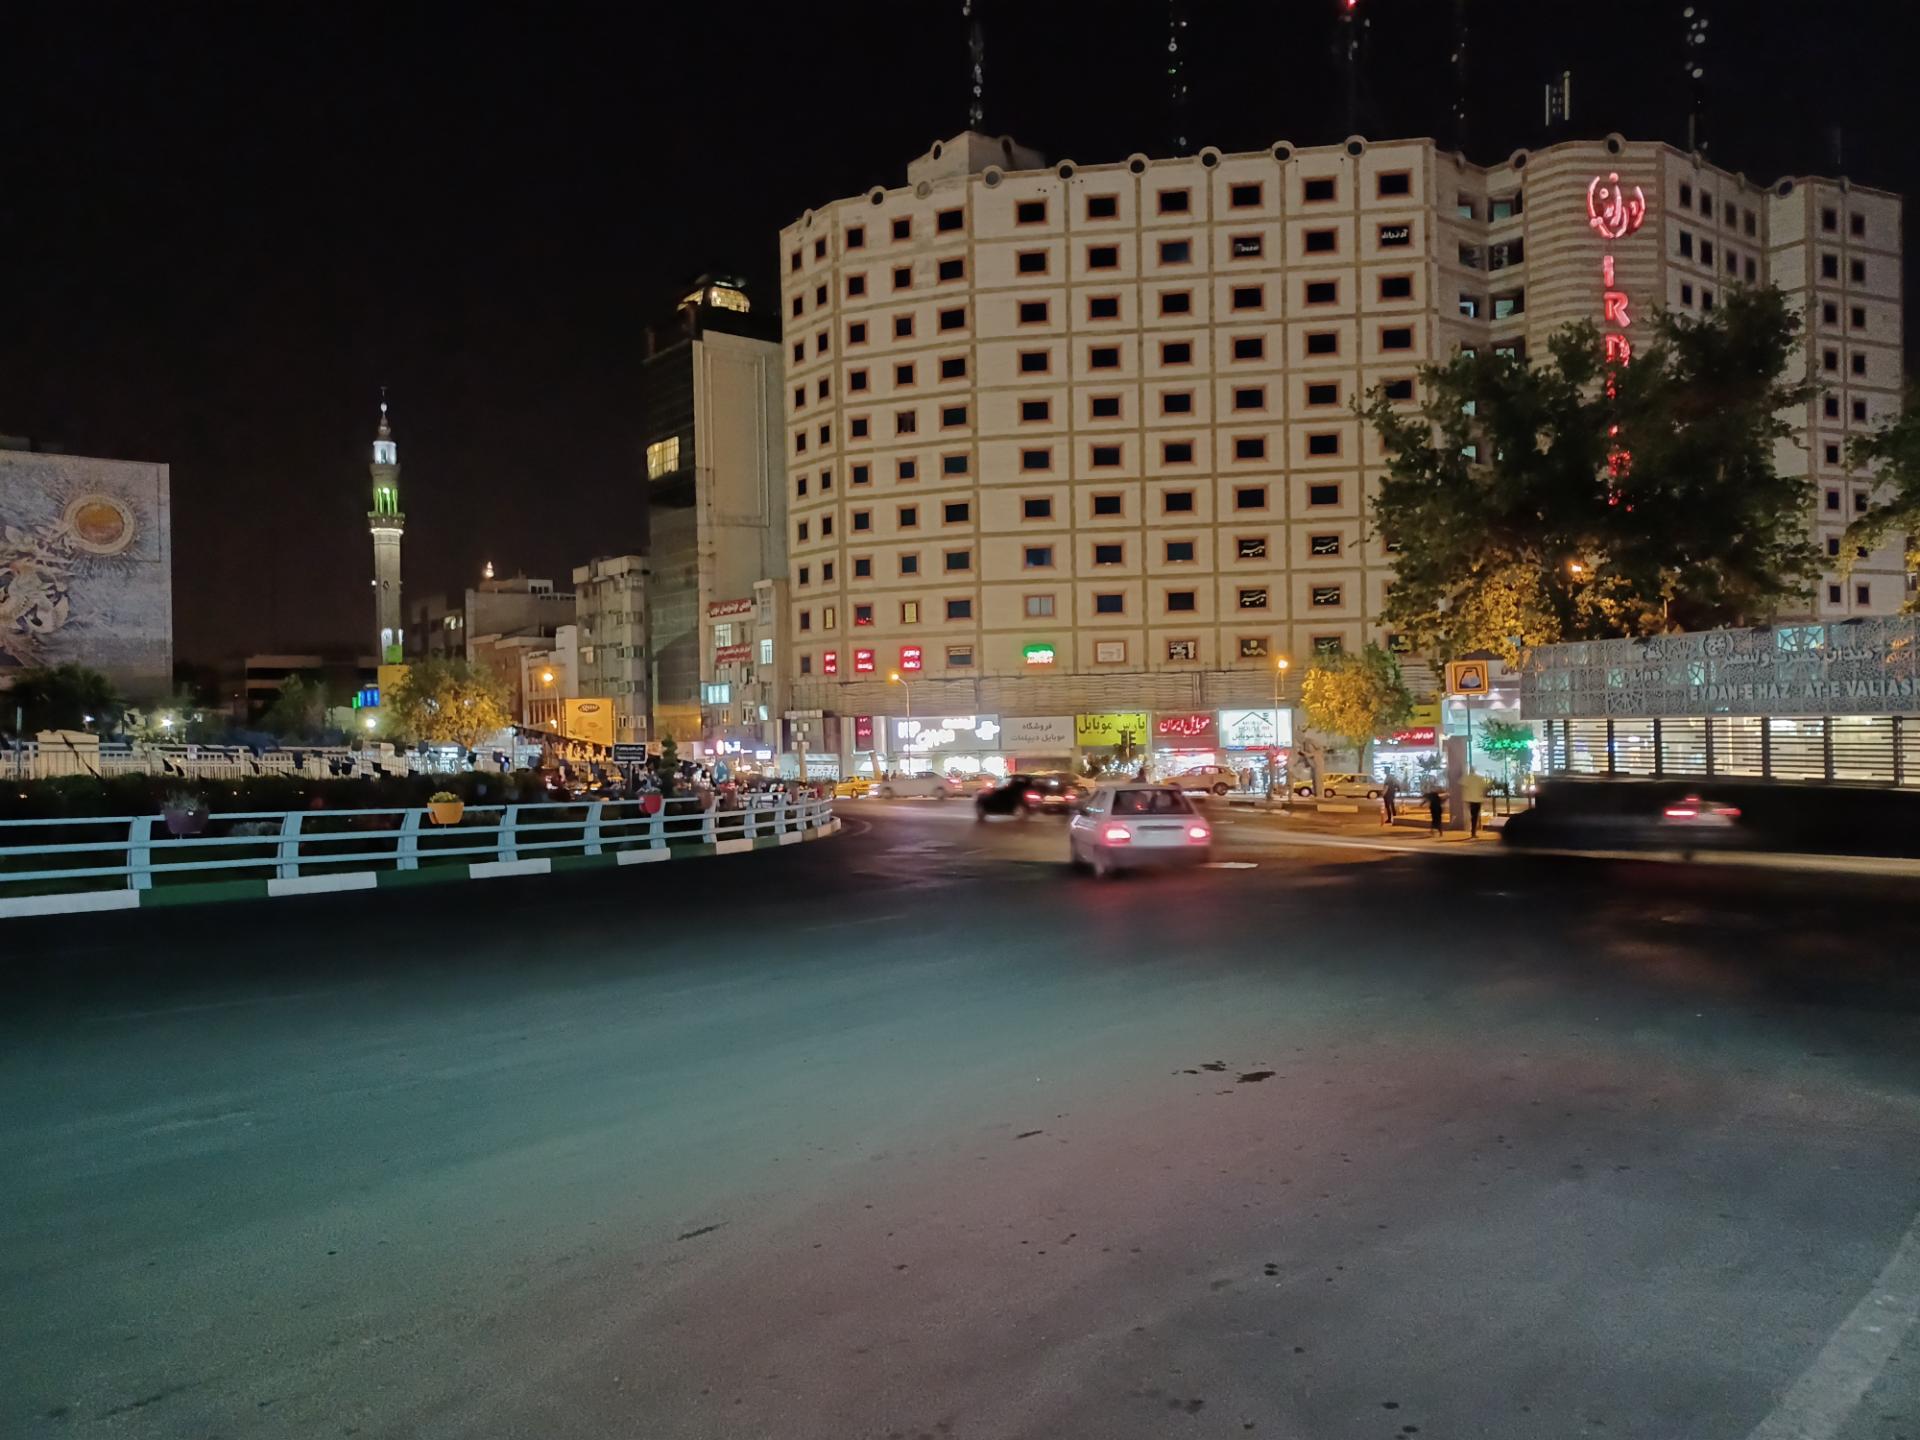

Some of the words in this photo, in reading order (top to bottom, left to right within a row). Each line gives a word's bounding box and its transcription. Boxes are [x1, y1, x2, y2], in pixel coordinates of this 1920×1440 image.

[1688, 683, 1753, 701] EYDAN-E
[1758, 680, 1840, 699] HAZAT-E
[1022, 722, 1053, 732] فروشگاه
[1078, 713, 1112, 734] موبایل
[1159, 719, 1184, 733] ایران
[1183, 715, 1211, 734] موبایل
[1041, 734, 1066, 743] موبایل
